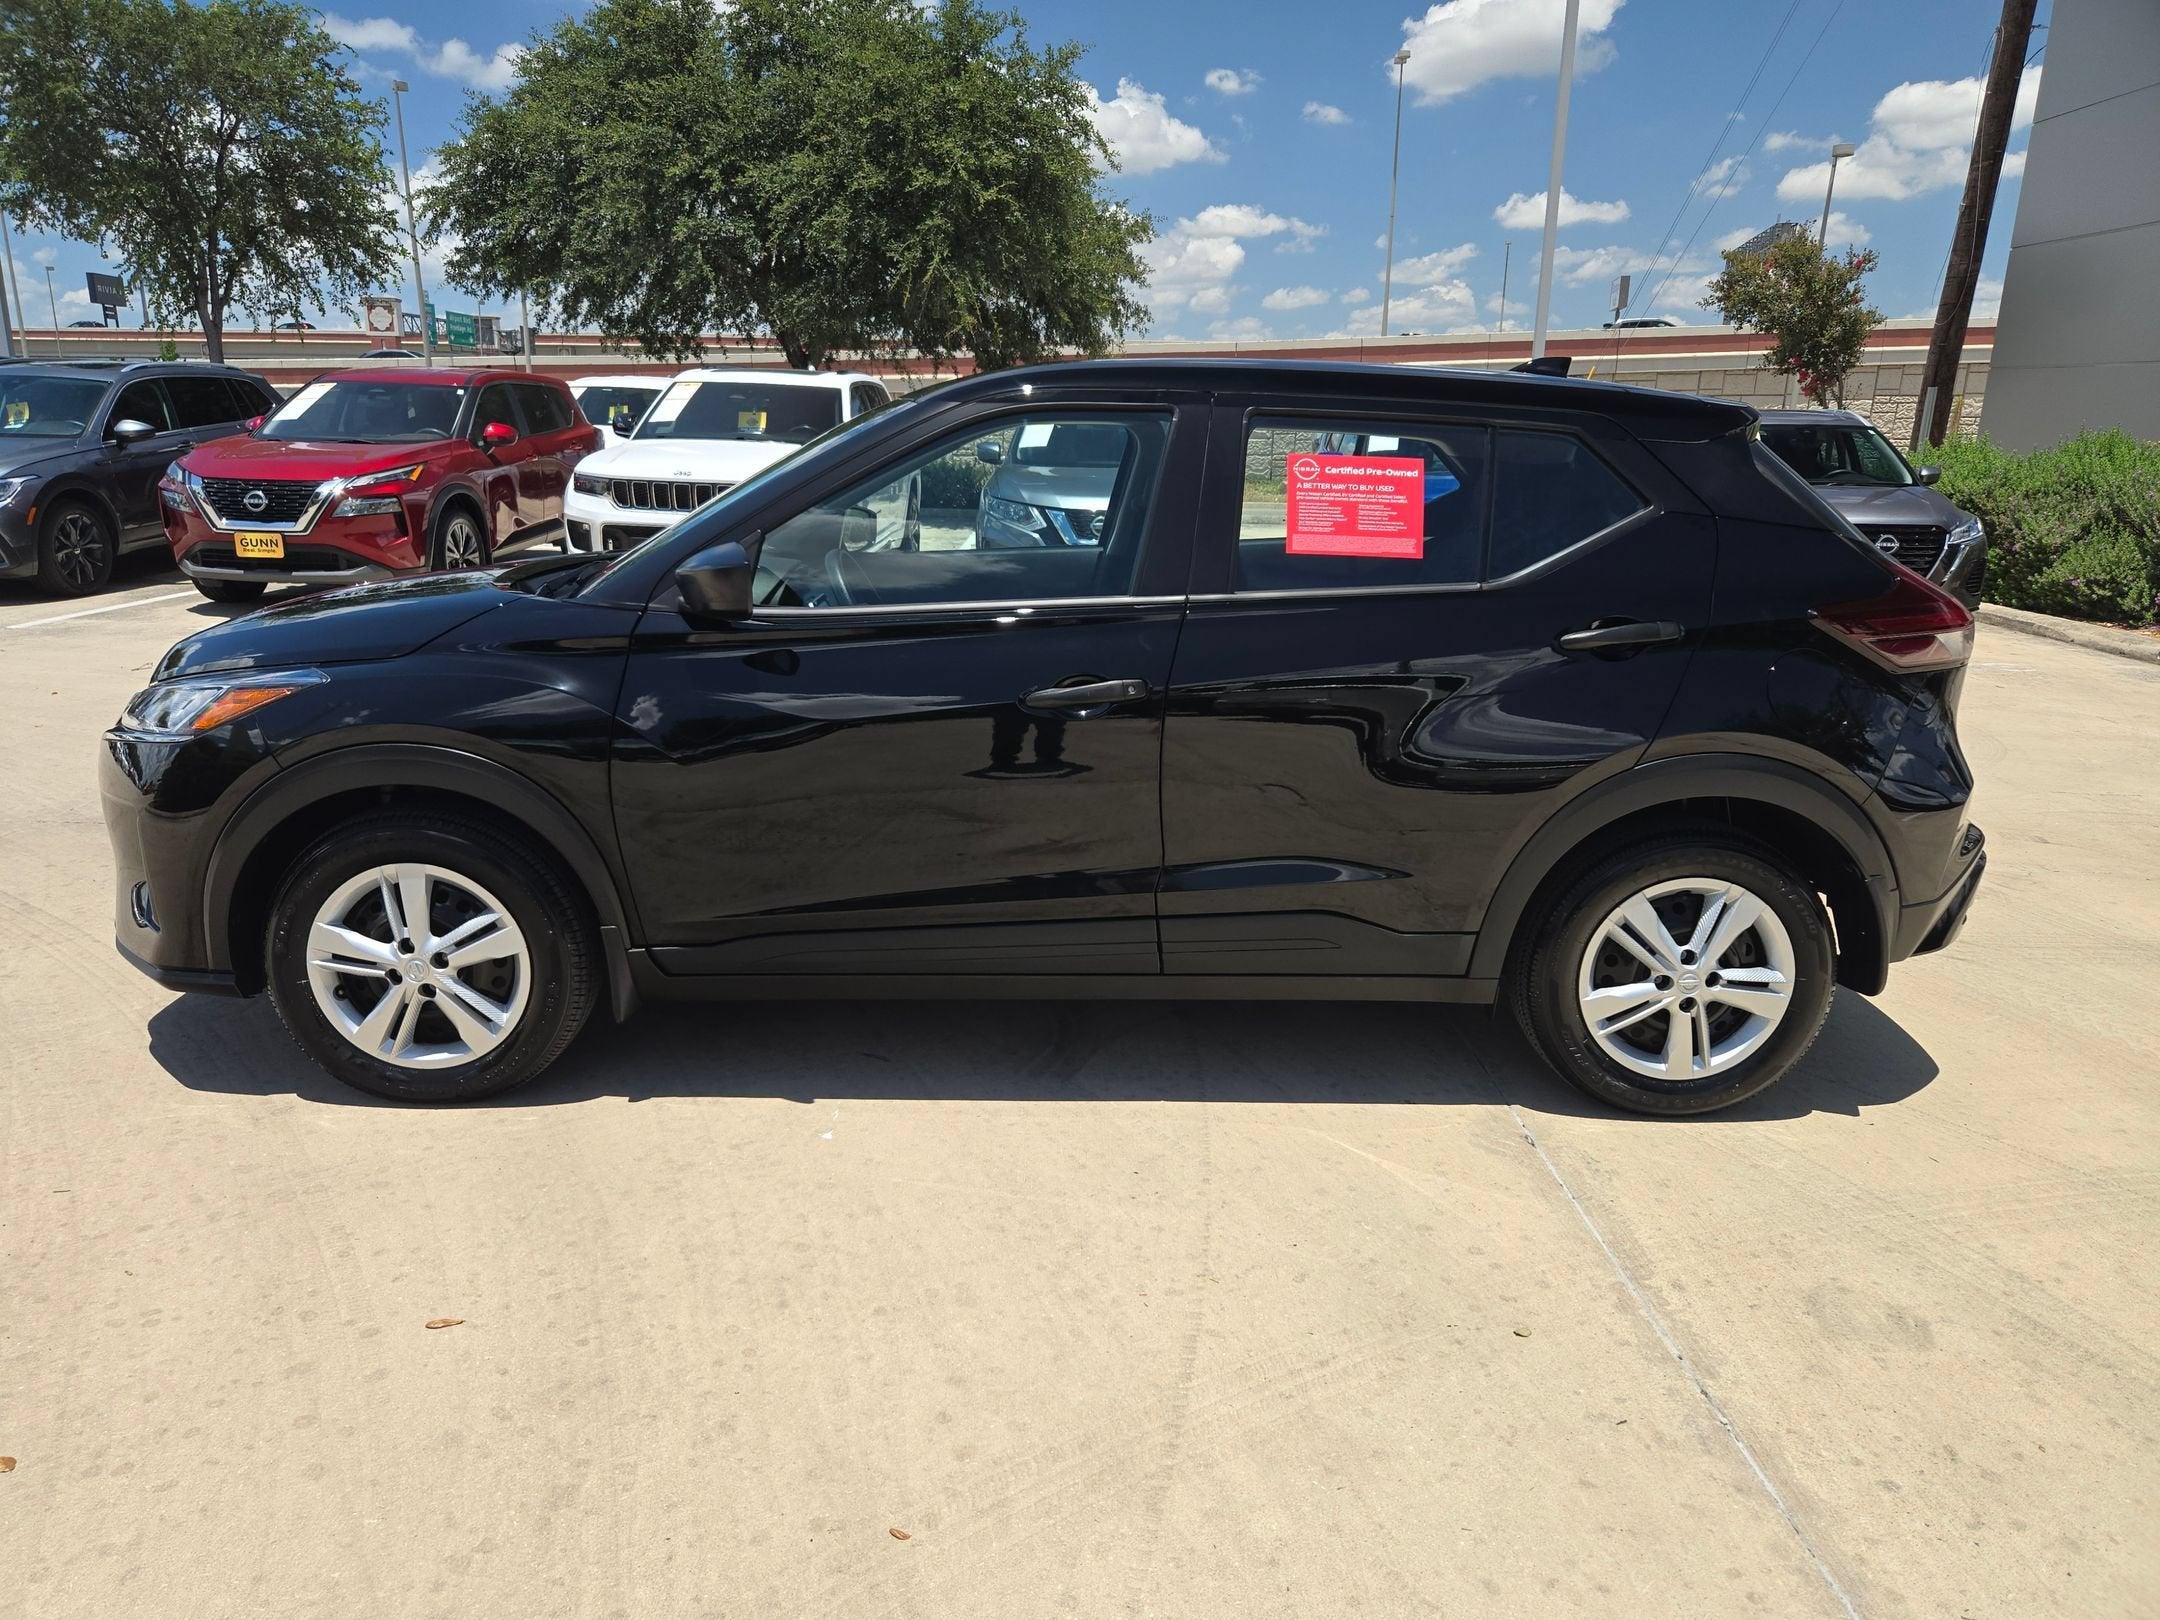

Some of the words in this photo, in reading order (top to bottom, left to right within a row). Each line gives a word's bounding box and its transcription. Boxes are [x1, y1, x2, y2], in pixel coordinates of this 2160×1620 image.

[1325, 466, 1365, 475] Certified
[1366, 467, 1419, 477] Pre-Owned
[240, 537, 279, 548] GUNN
